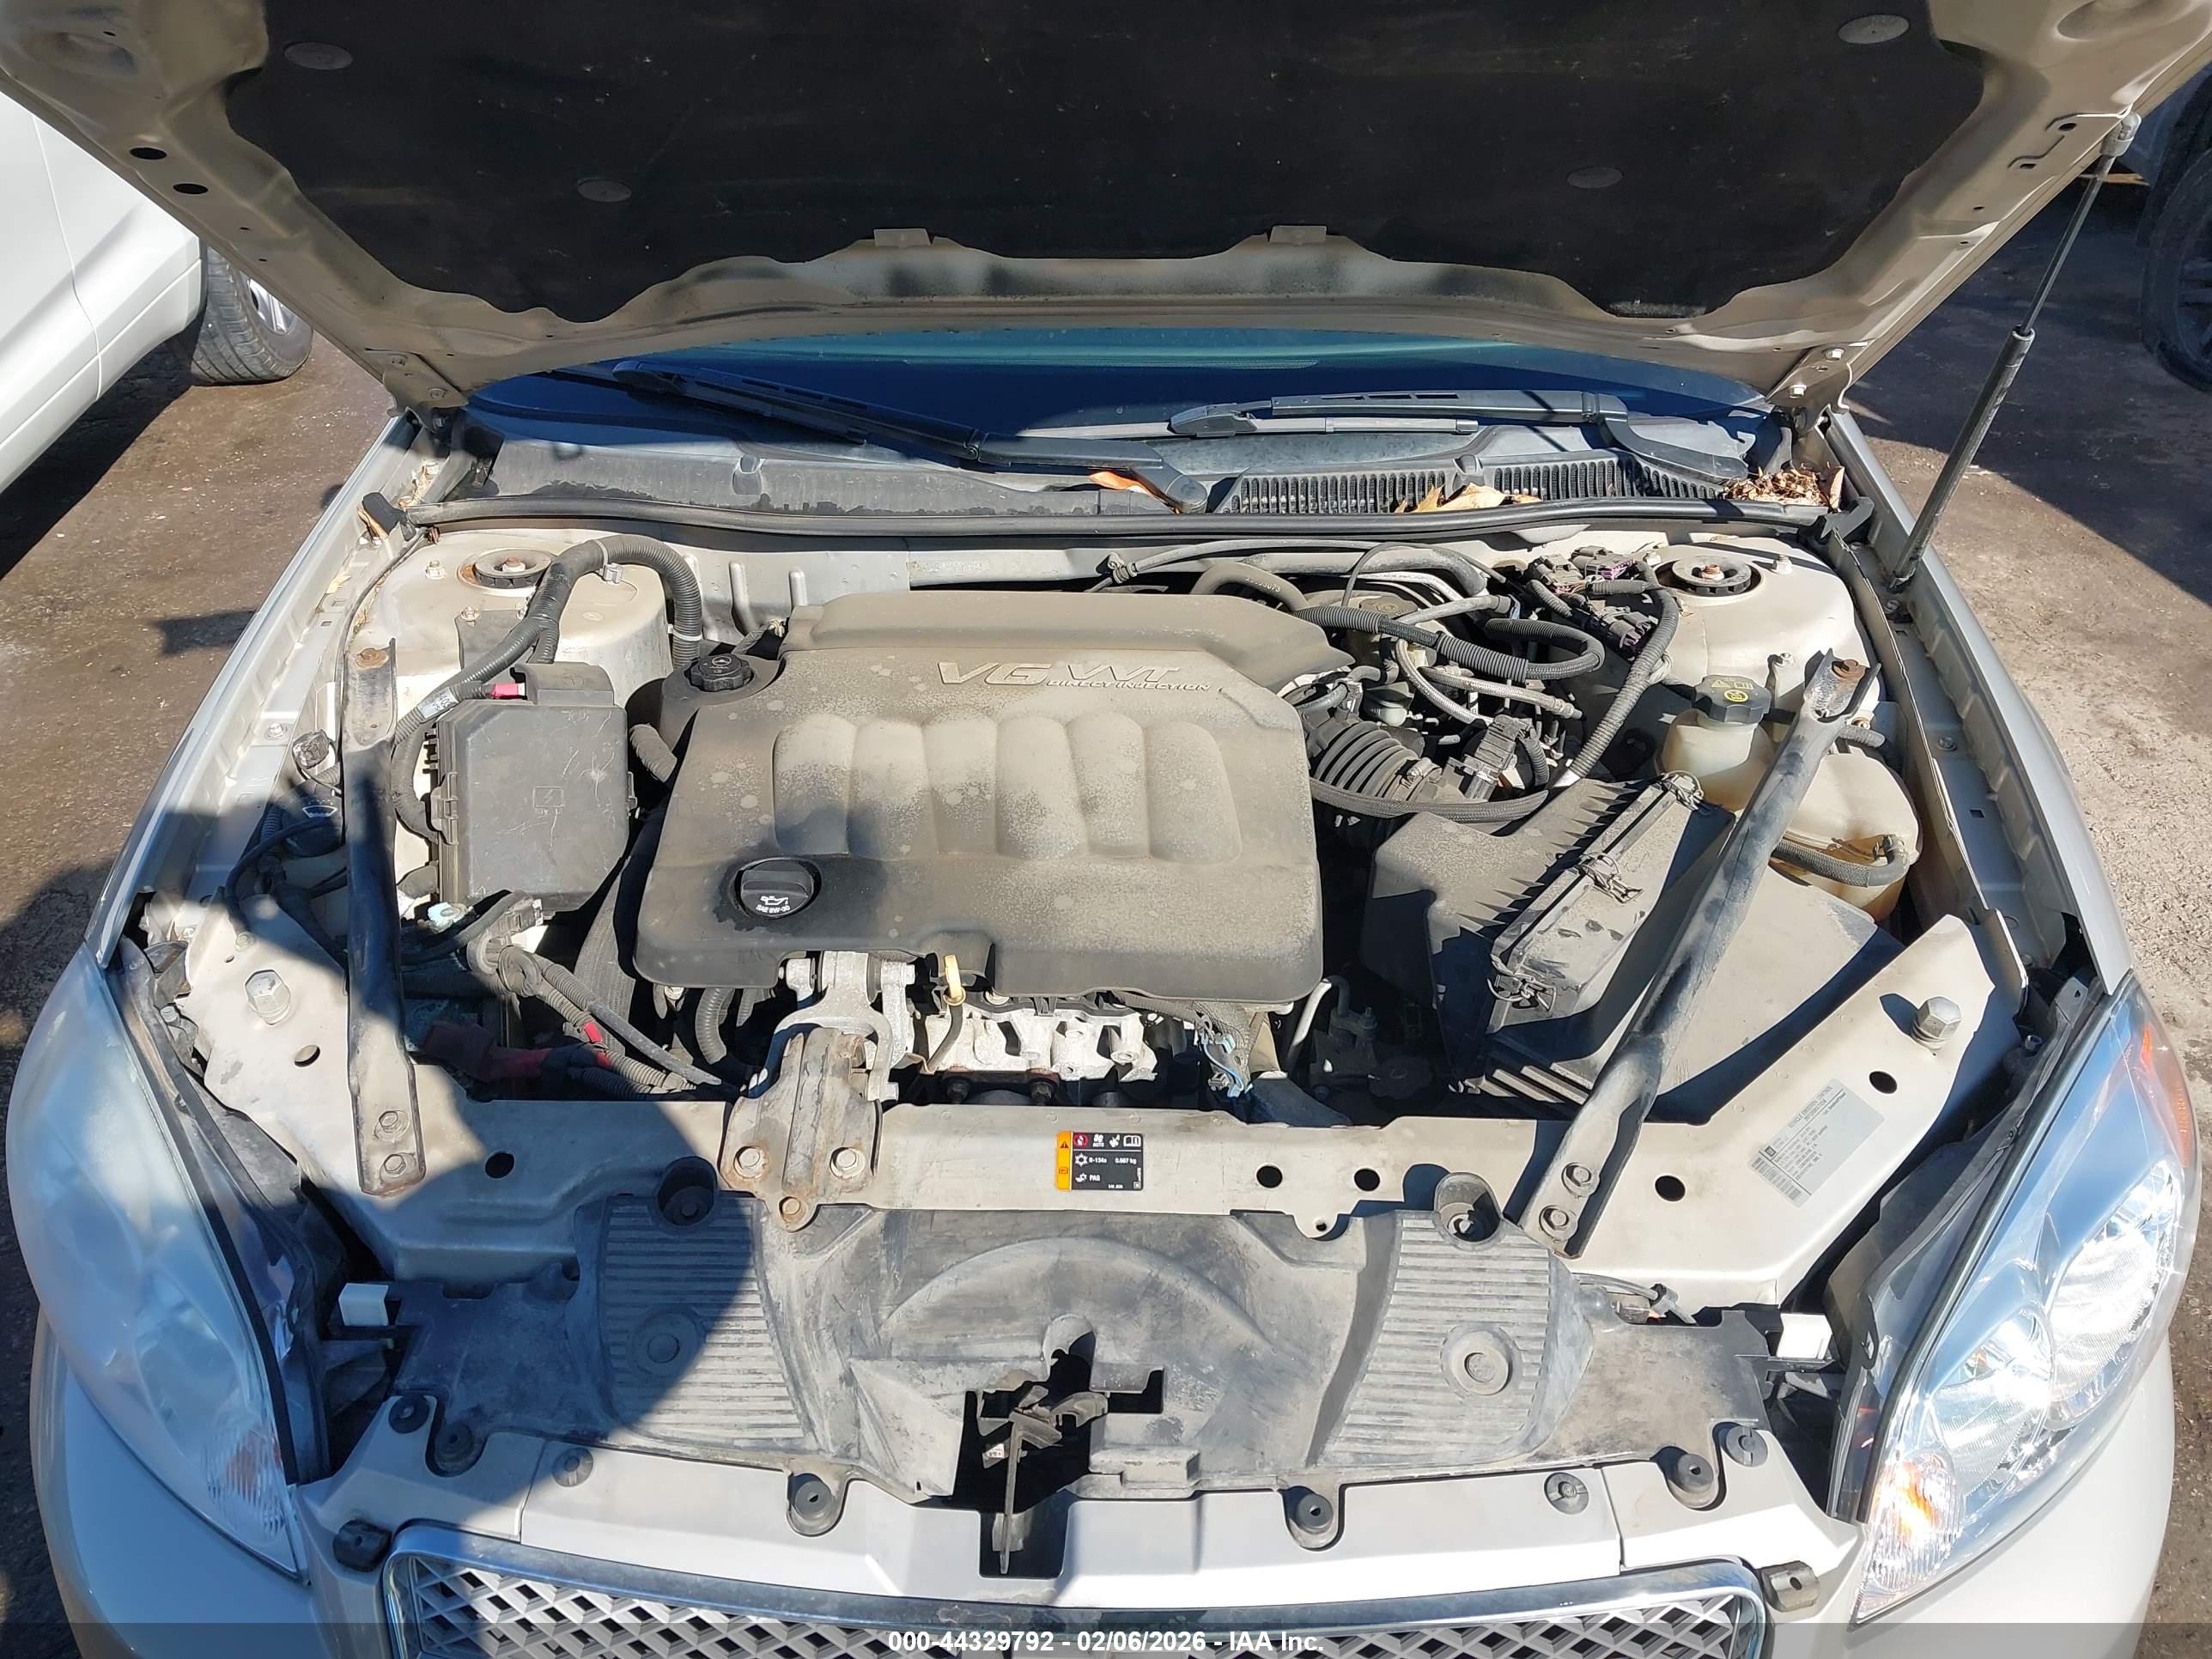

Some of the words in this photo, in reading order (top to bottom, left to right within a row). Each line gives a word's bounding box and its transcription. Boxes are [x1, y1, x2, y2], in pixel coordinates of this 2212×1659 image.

[937, 662, 1052, 685] V6
[1067, 664, 1181, 683] VVT
[1045, 678, 1115, 689] DIRECT
[1115, 681, 1211, 692] INJECTION
[756, 904, 769, 913] SAE
